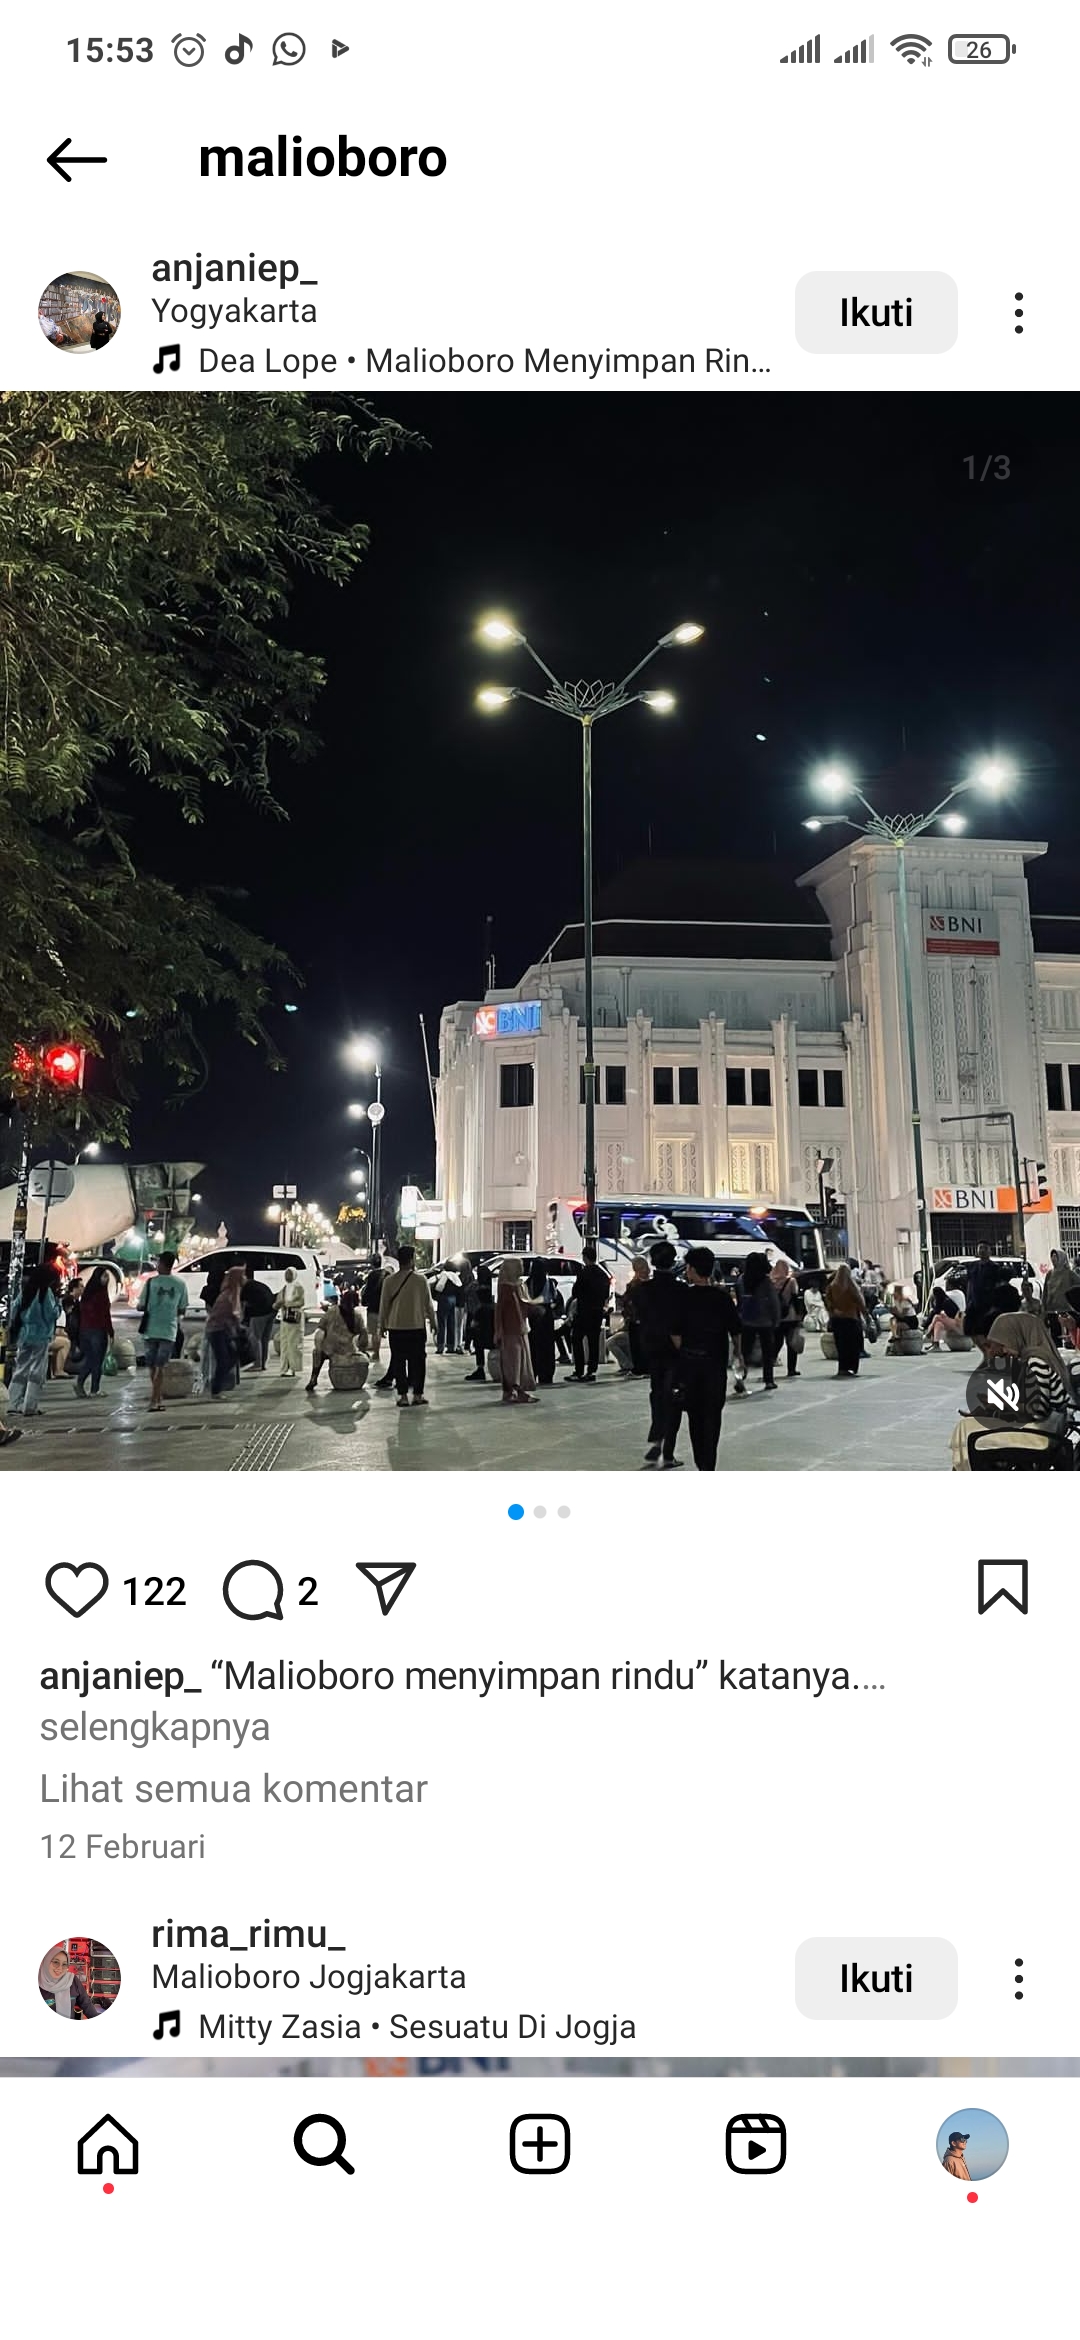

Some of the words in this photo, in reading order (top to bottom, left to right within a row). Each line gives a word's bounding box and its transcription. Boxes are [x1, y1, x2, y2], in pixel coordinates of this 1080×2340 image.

[948, 916, 982, 934] BNI
[498, 1005, 540, 1032] BNI
[956, 1190, 994, 1209] BNI
